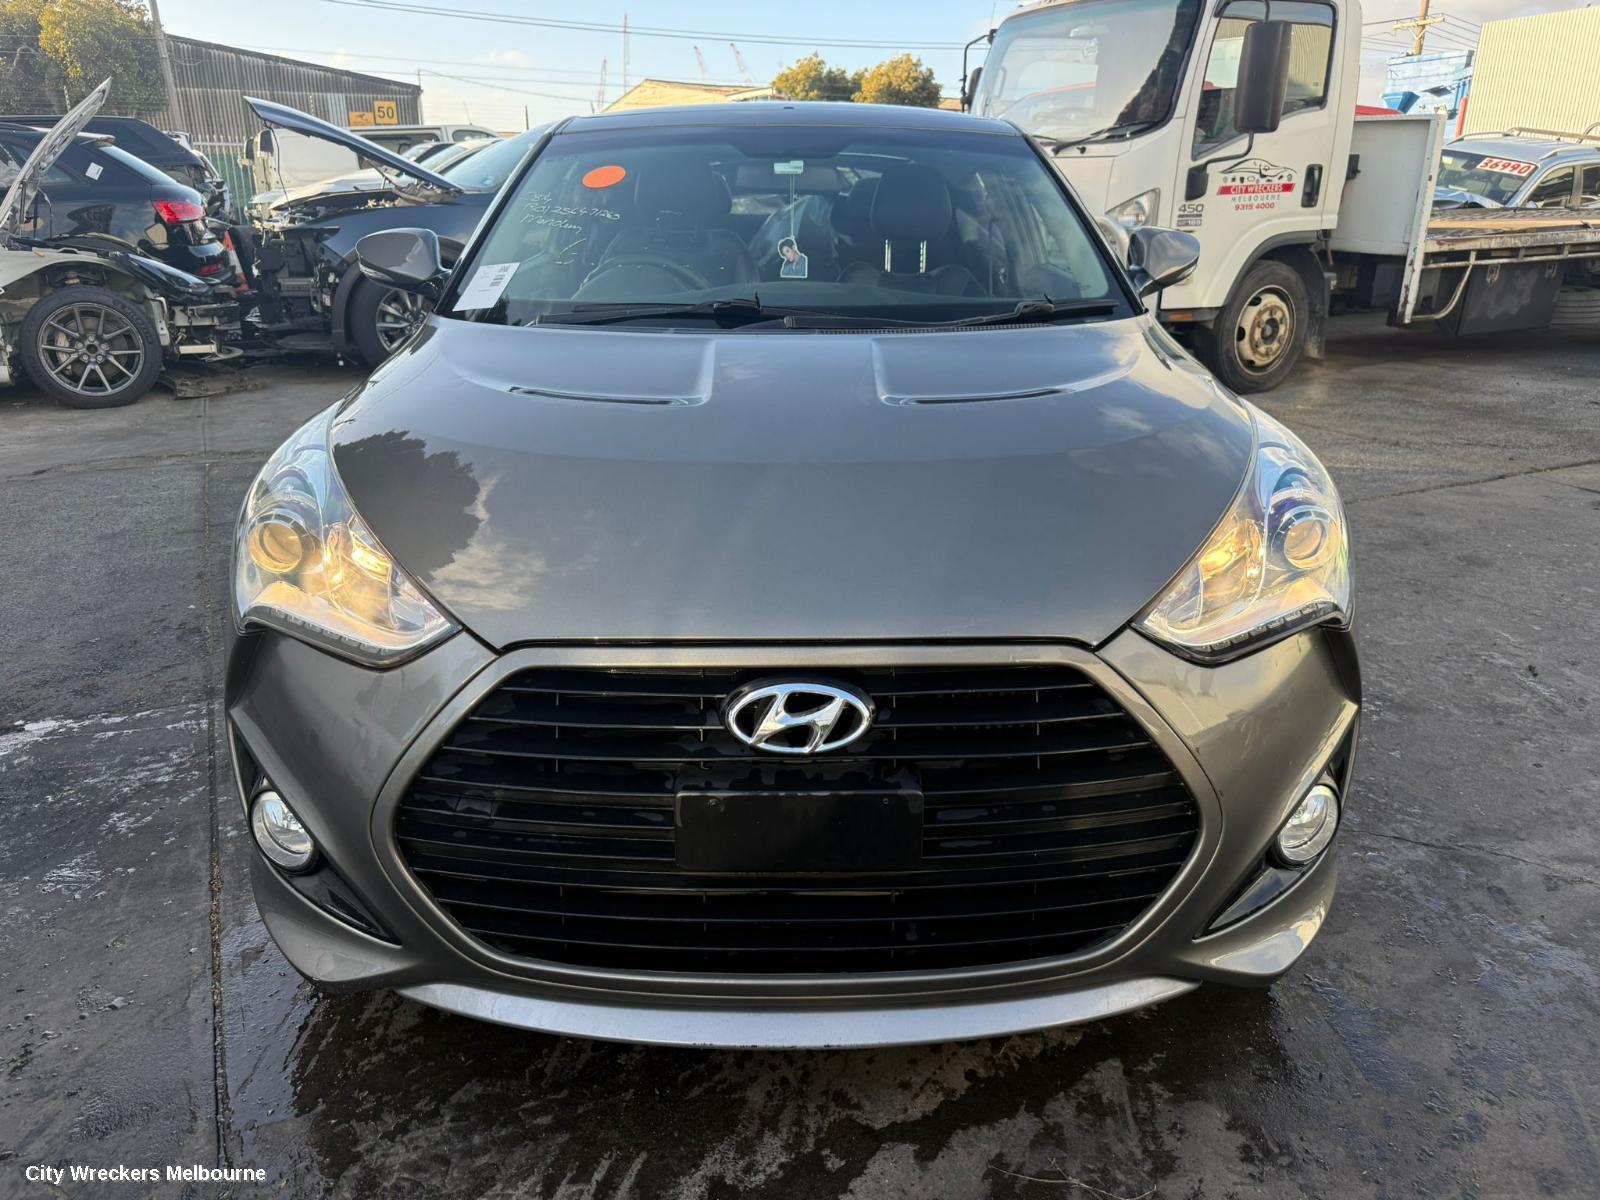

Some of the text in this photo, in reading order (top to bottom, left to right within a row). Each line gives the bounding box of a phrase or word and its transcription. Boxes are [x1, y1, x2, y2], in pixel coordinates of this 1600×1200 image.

[377, 105, 395, 119] 50
[1230, 183, 1284, 194] CITY WRECKERS
[1231, 194, 1281, 203] MELBOURNE
[1178, 203, 1204, 213] 450
[1234, 202, 1276, 211] 9315 4000
